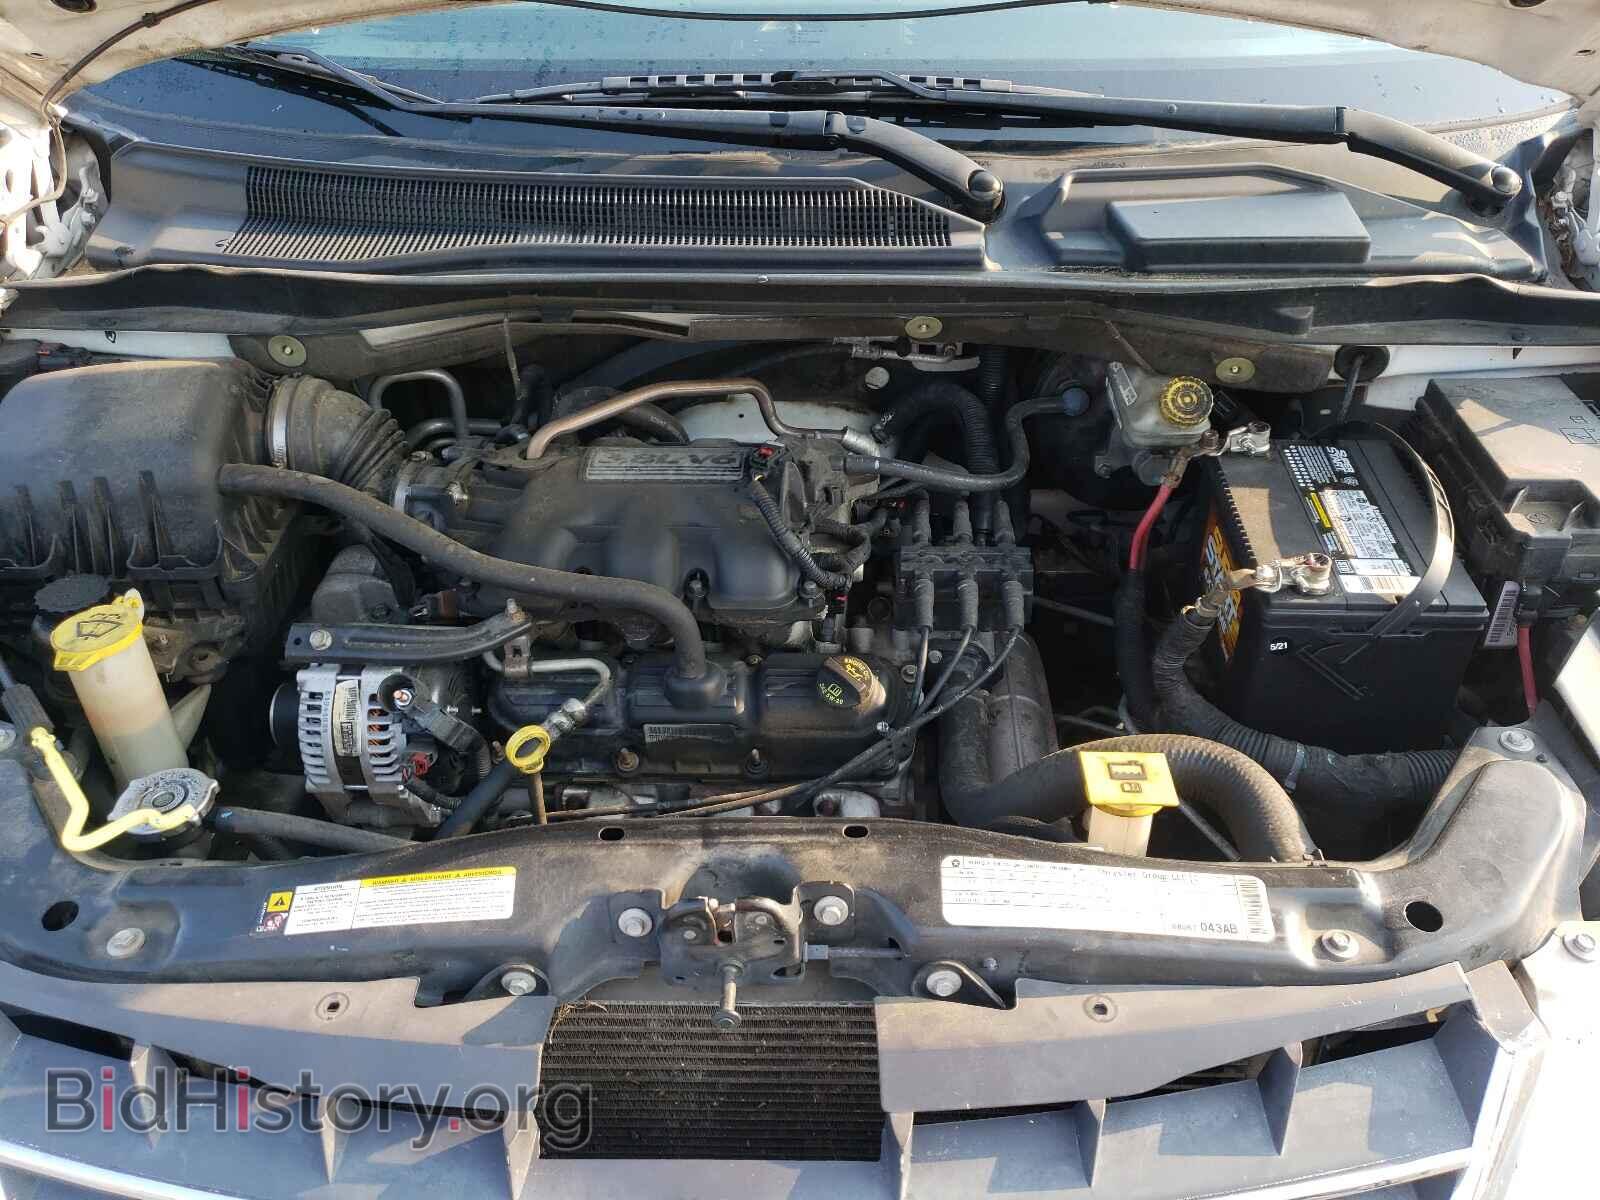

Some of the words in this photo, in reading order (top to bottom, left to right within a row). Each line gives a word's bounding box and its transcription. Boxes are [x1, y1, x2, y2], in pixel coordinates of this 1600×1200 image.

[688, 451, 738, 465] V6
[1270, 641, 1288, 651] 5/21
[825, 692, 844, 705] 5W-20
